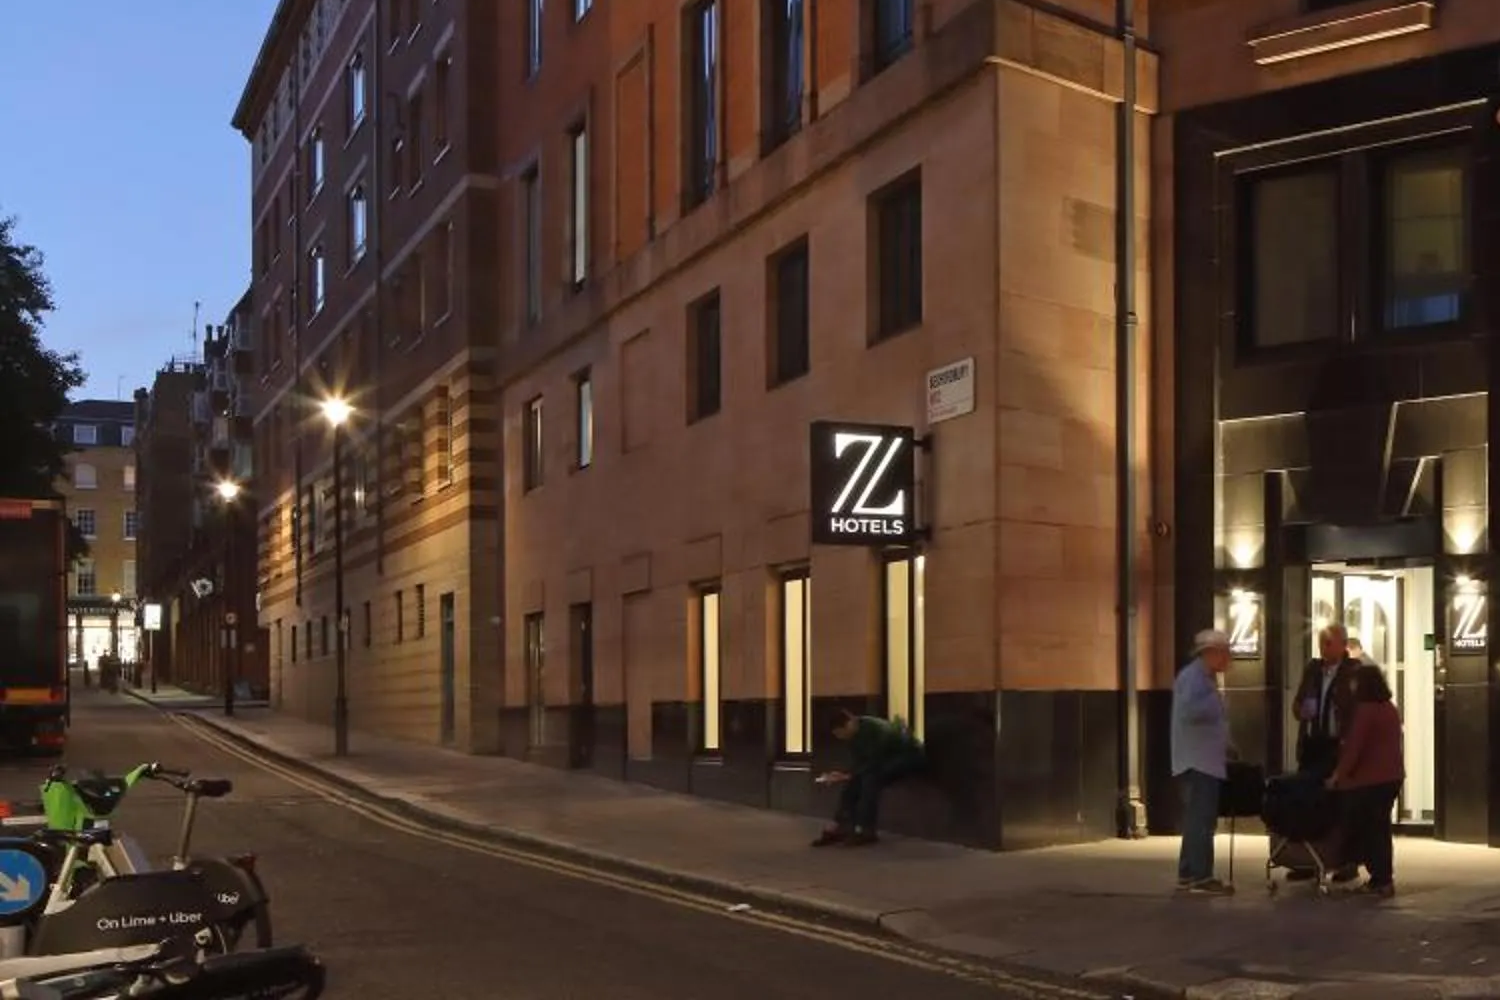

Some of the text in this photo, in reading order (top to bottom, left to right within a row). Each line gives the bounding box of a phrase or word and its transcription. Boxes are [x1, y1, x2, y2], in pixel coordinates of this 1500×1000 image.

[831, 433, 904, 515] Z
[831, 517, 904, 535] HOTELS
[1453, 595, 1486, 638] Z
[217, 892, 240, 905] Uber
[97, 917, 118, 930] On
[121, 914, 155, 928] Lime
[169, 911, 202, 924] Uber
